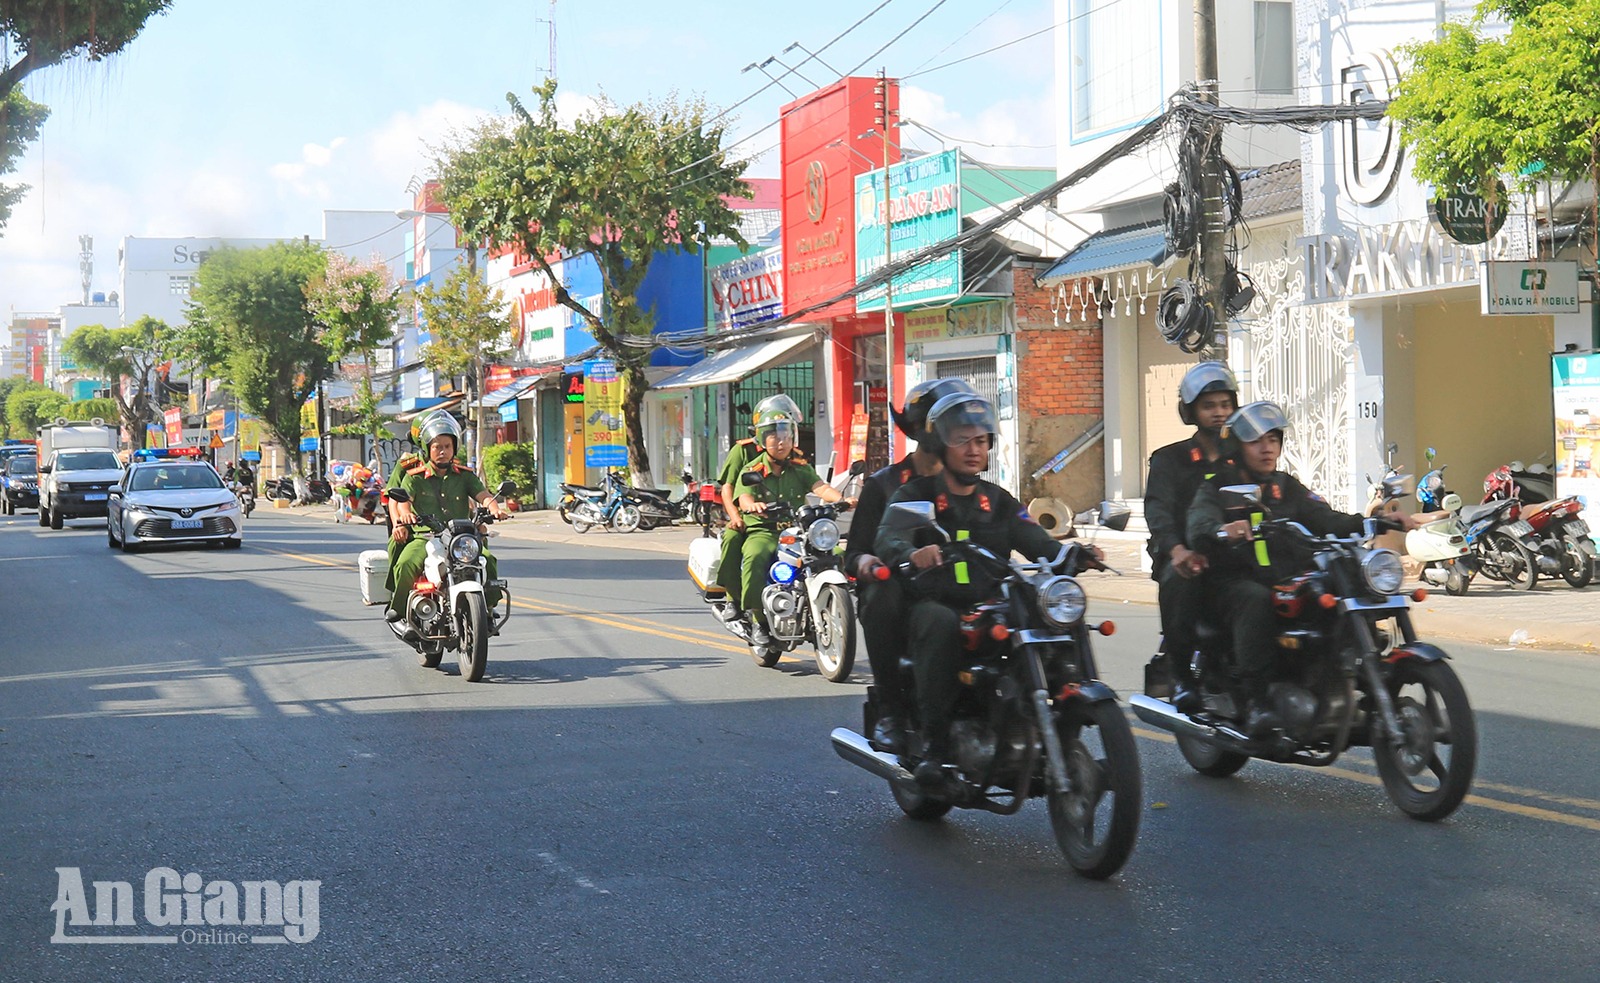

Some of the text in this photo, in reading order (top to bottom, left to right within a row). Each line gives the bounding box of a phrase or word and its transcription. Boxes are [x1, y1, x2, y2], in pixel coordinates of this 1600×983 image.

[878, 184, 955, 225] HOÀNG AN
[1444, 197, 1499, 219] TRAKY
[1295, 217, 1432, 301] TRAKY
[728, 270, 782, 309] CHIN
[1492, 294, 1523, 306] HOÀNG
[1542, 296, 1576, 306] MOBILE
[1358, 401, 1378, 419] 150
[593, 431, 612, 442] 390
